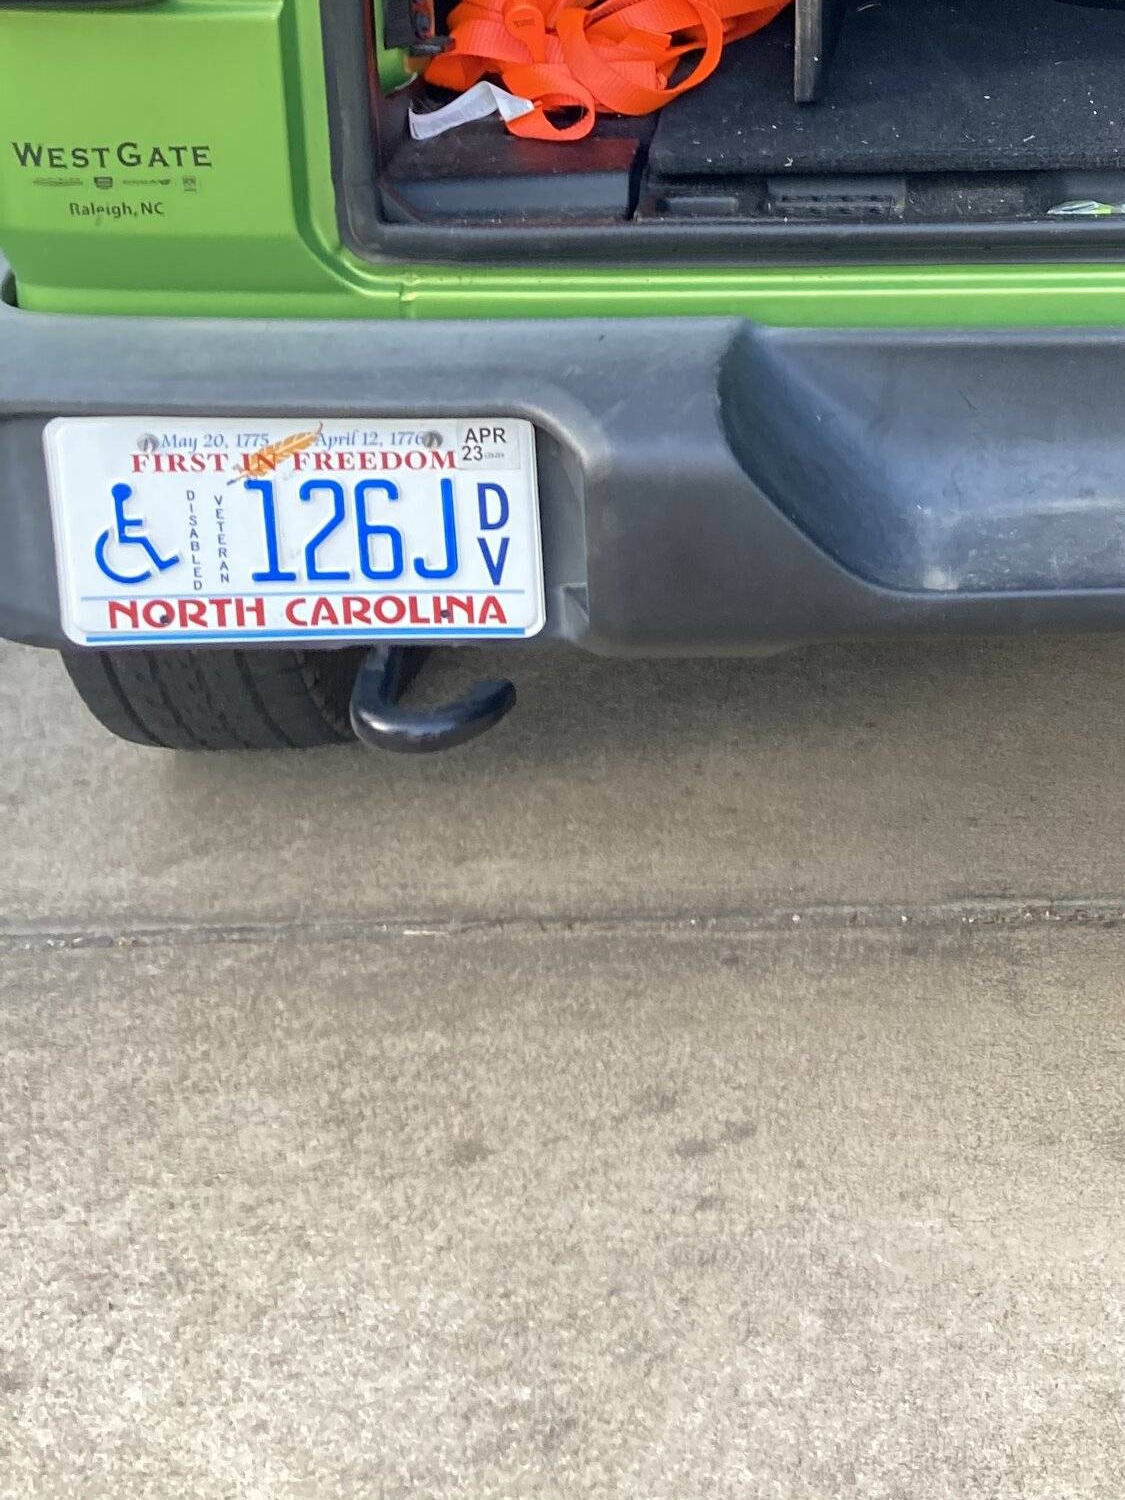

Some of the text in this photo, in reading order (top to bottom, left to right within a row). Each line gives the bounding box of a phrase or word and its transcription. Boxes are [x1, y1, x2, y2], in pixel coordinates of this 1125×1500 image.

[69, 202, 164, 218] Raleigh, NC
[160, 433, 269, 452] May 20, 1775
[315, 429, 358, 449] April
[361, 432, 384, 446] 12,
[465, 428, 506, 444] APR
[131, 450, 458, 473] FIRST IN FREEDOM
[462, 445, 483, 461] 23
[186, 490, 203, 590] DISABLED
[214, 495, 230, 583] VETERAN
[244, 478, 459, 582] 126J
[108, 595, 508, 629] NORTH CAROLINA
